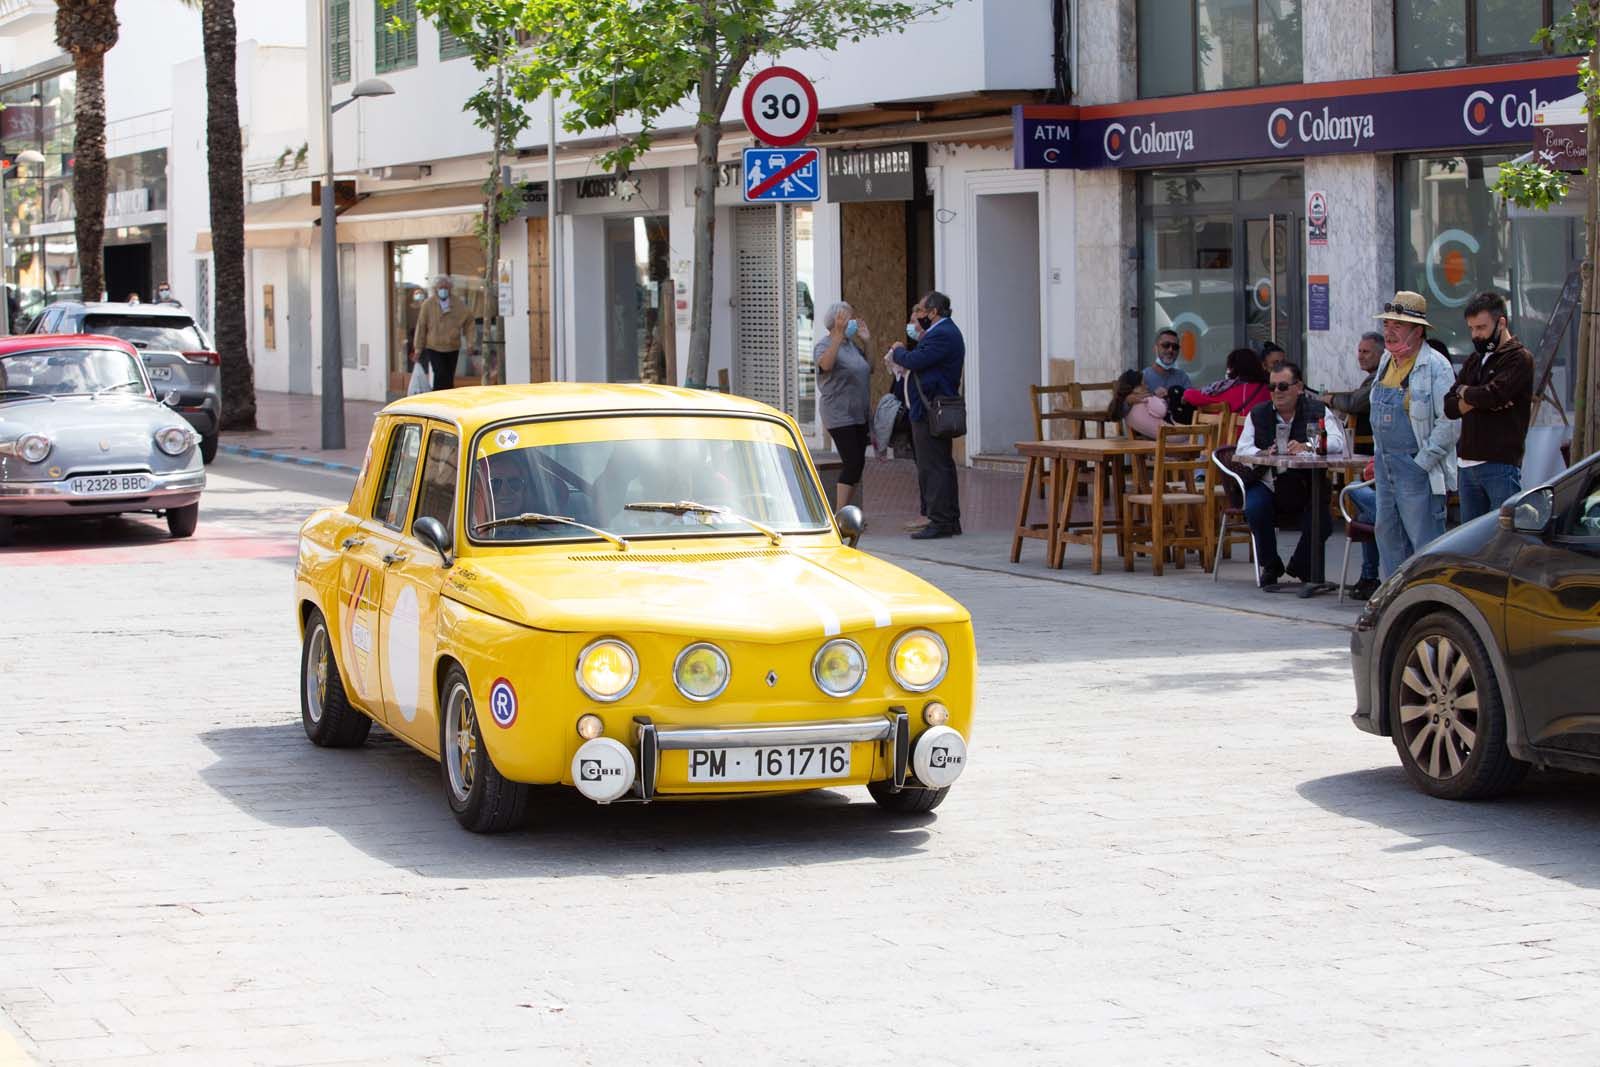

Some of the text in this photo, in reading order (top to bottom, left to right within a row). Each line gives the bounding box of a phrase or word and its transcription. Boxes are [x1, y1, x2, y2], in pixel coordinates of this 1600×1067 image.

[761, 93, 801, 120] 30
[1034, 125, 1071, 140] ATM
[1298, 106, 1375, 147] Colonya
[1130, 121, 1194, 159] Colonya
[828, 151, 910, 179] LA SANTA BARBER
[87, 479, 118, 492] 2328
[497, 693, 508, 716] R
[588, 768, 622, 776] CIBIE
[691, 746, 846, 778] PM 161716
[937, 756, 962, 764] CIBIE
